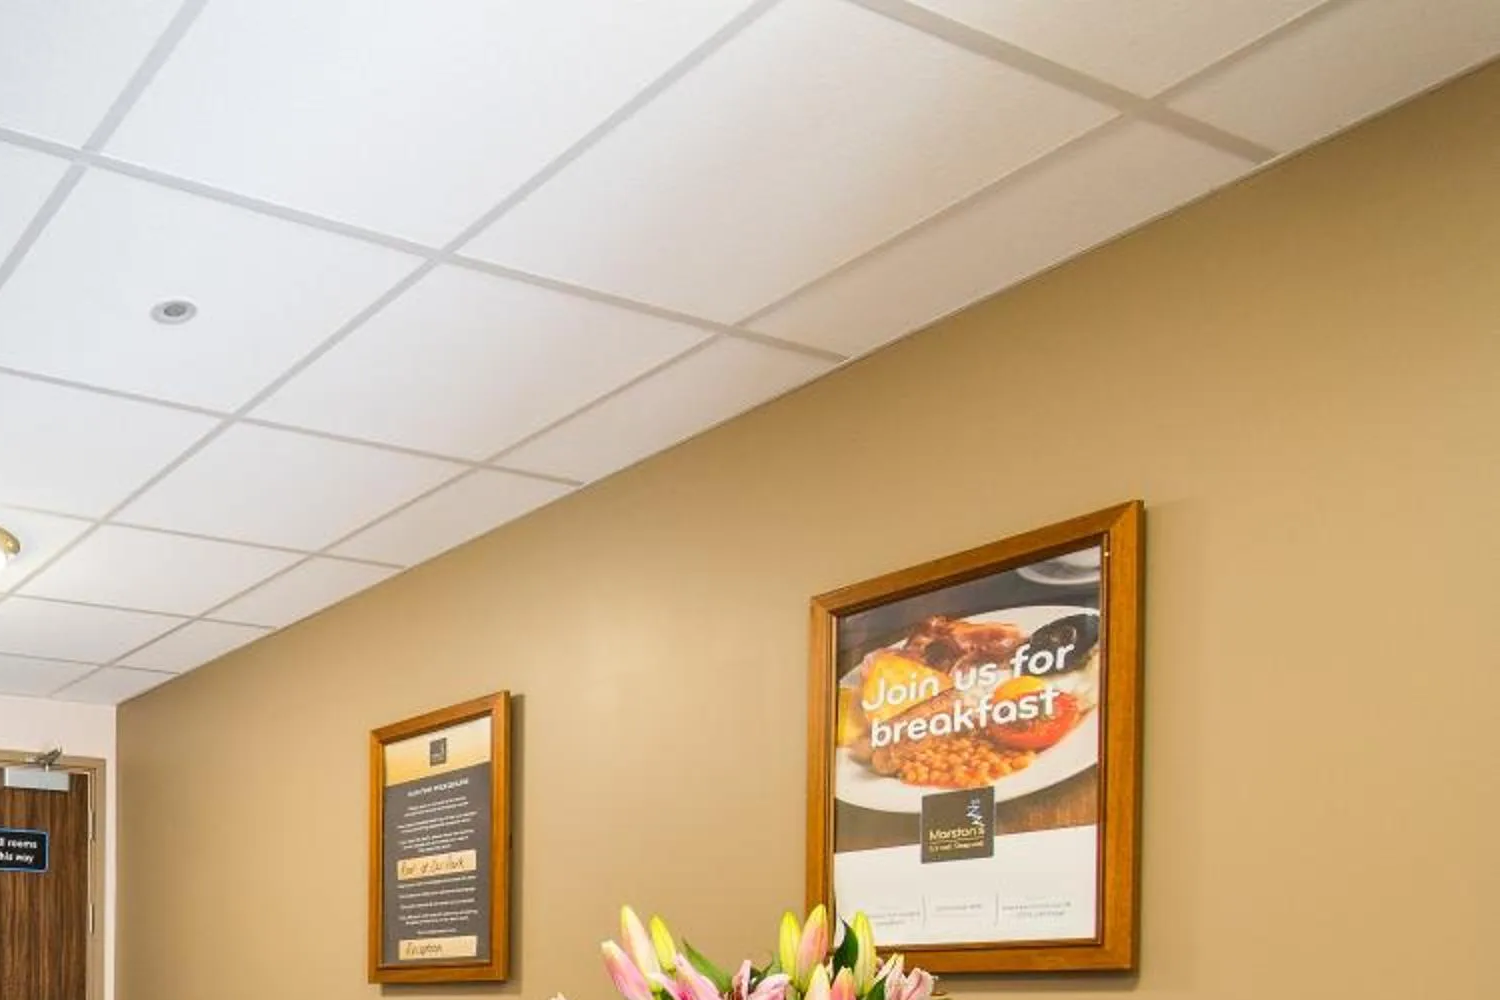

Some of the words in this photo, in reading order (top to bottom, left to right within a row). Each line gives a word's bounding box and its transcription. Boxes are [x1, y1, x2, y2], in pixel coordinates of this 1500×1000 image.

[861, 672, 939, 711] Join
[955, 662, 998, 691] us
[1010, 644, 1075, 678] for
[871, 688, 1060, 748] breakfast
[7, 839, 37, 849] rooms
[15, 854, 34, 864] way
